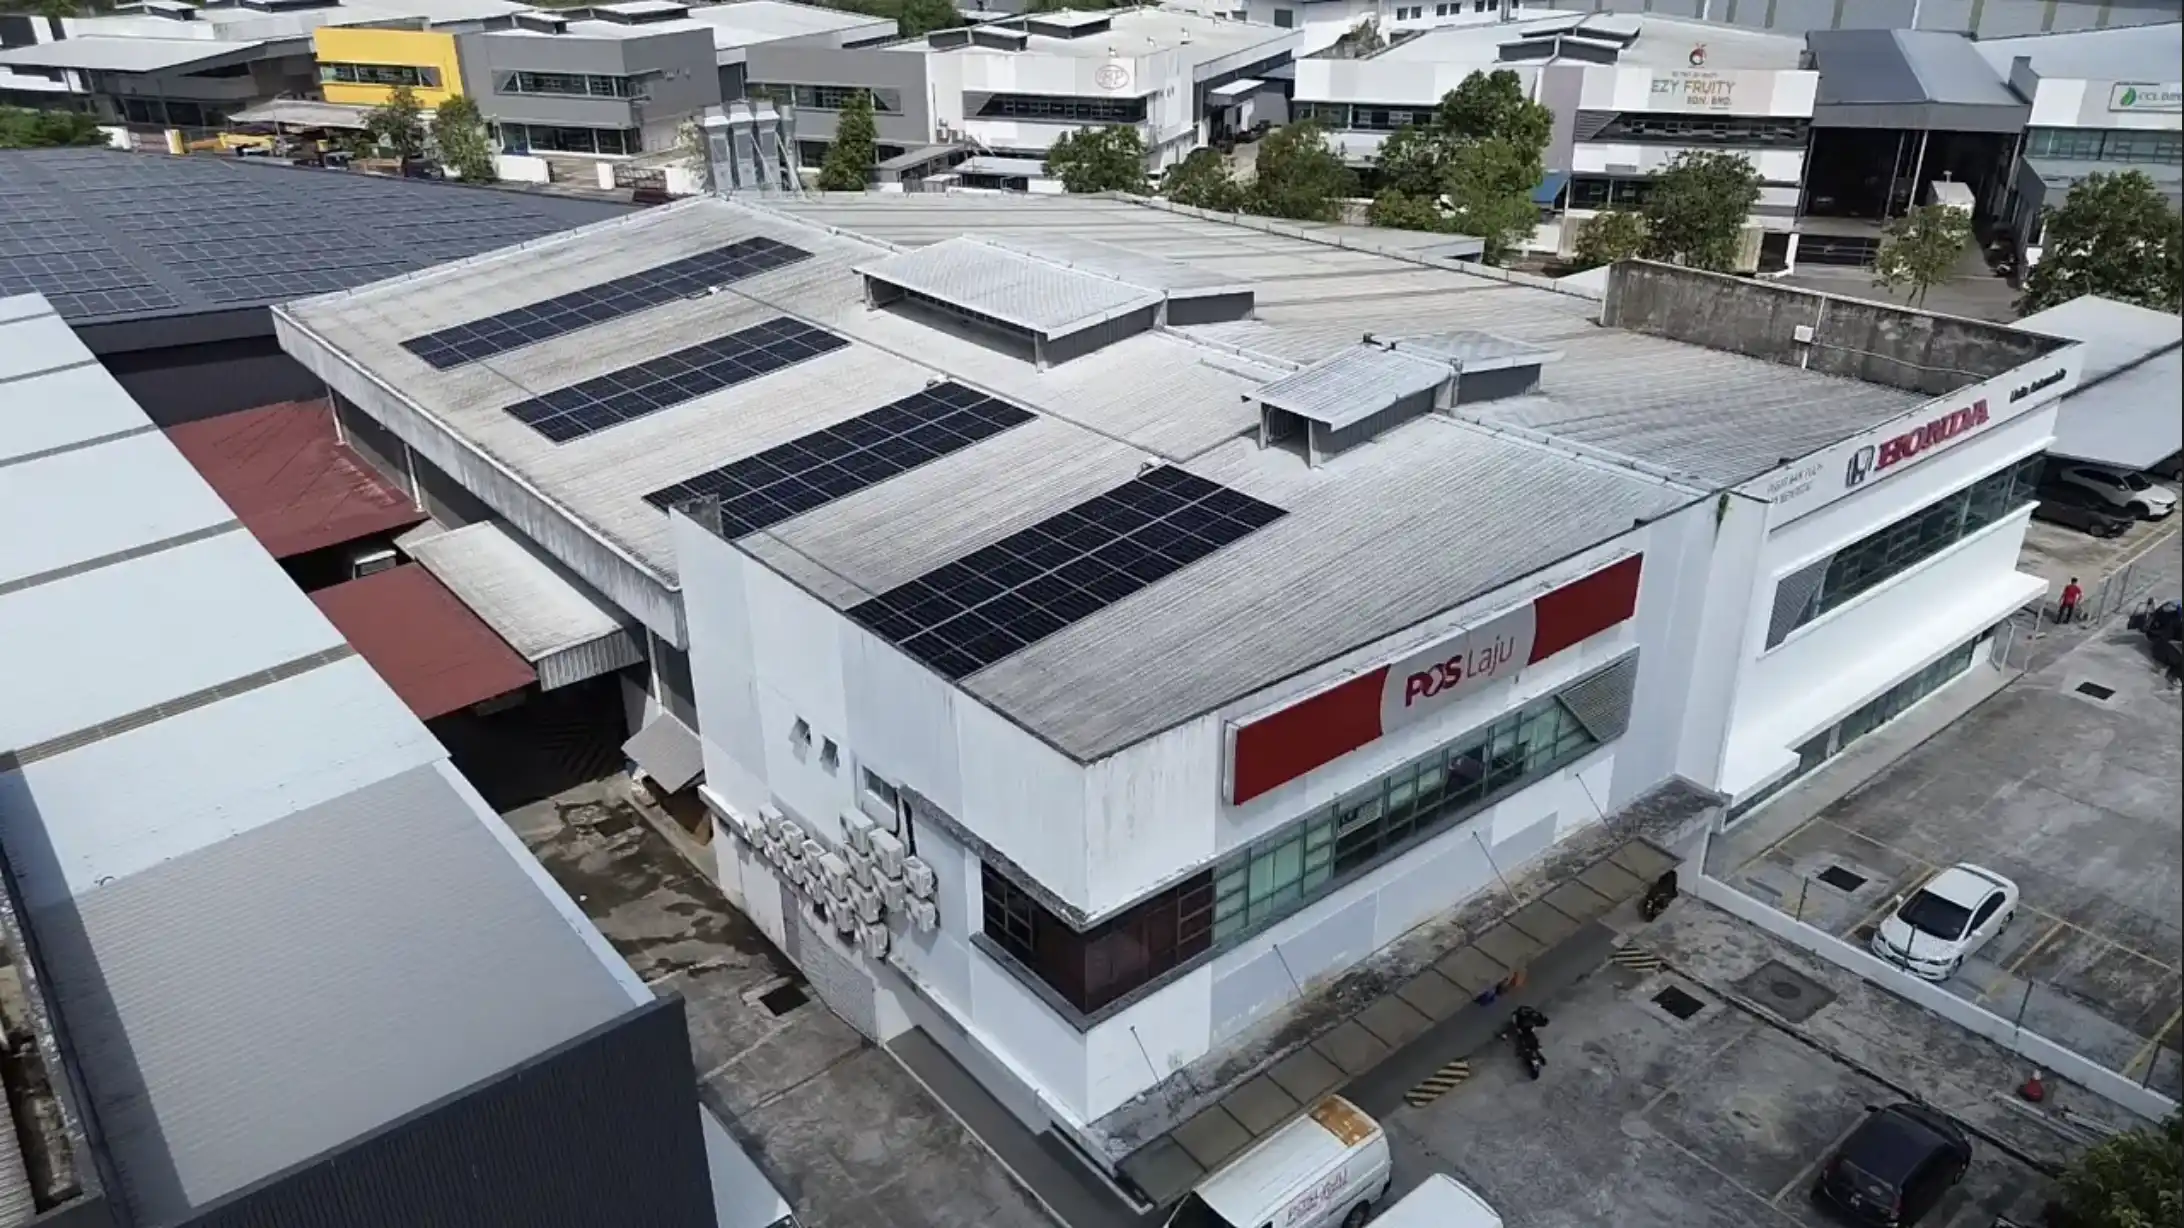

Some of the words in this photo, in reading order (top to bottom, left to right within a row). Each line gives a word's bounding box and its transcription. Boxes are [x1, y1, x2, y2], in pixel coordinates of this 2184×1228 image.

[1651, 79, 1679, 95] EZY
[1683, 80, 1736, 94] FRUITY
[1874, 398, 1990, 471] HONDA
[1405, 654, 1463, 708] POS
[1466, 634, 1515, 678] Laju
